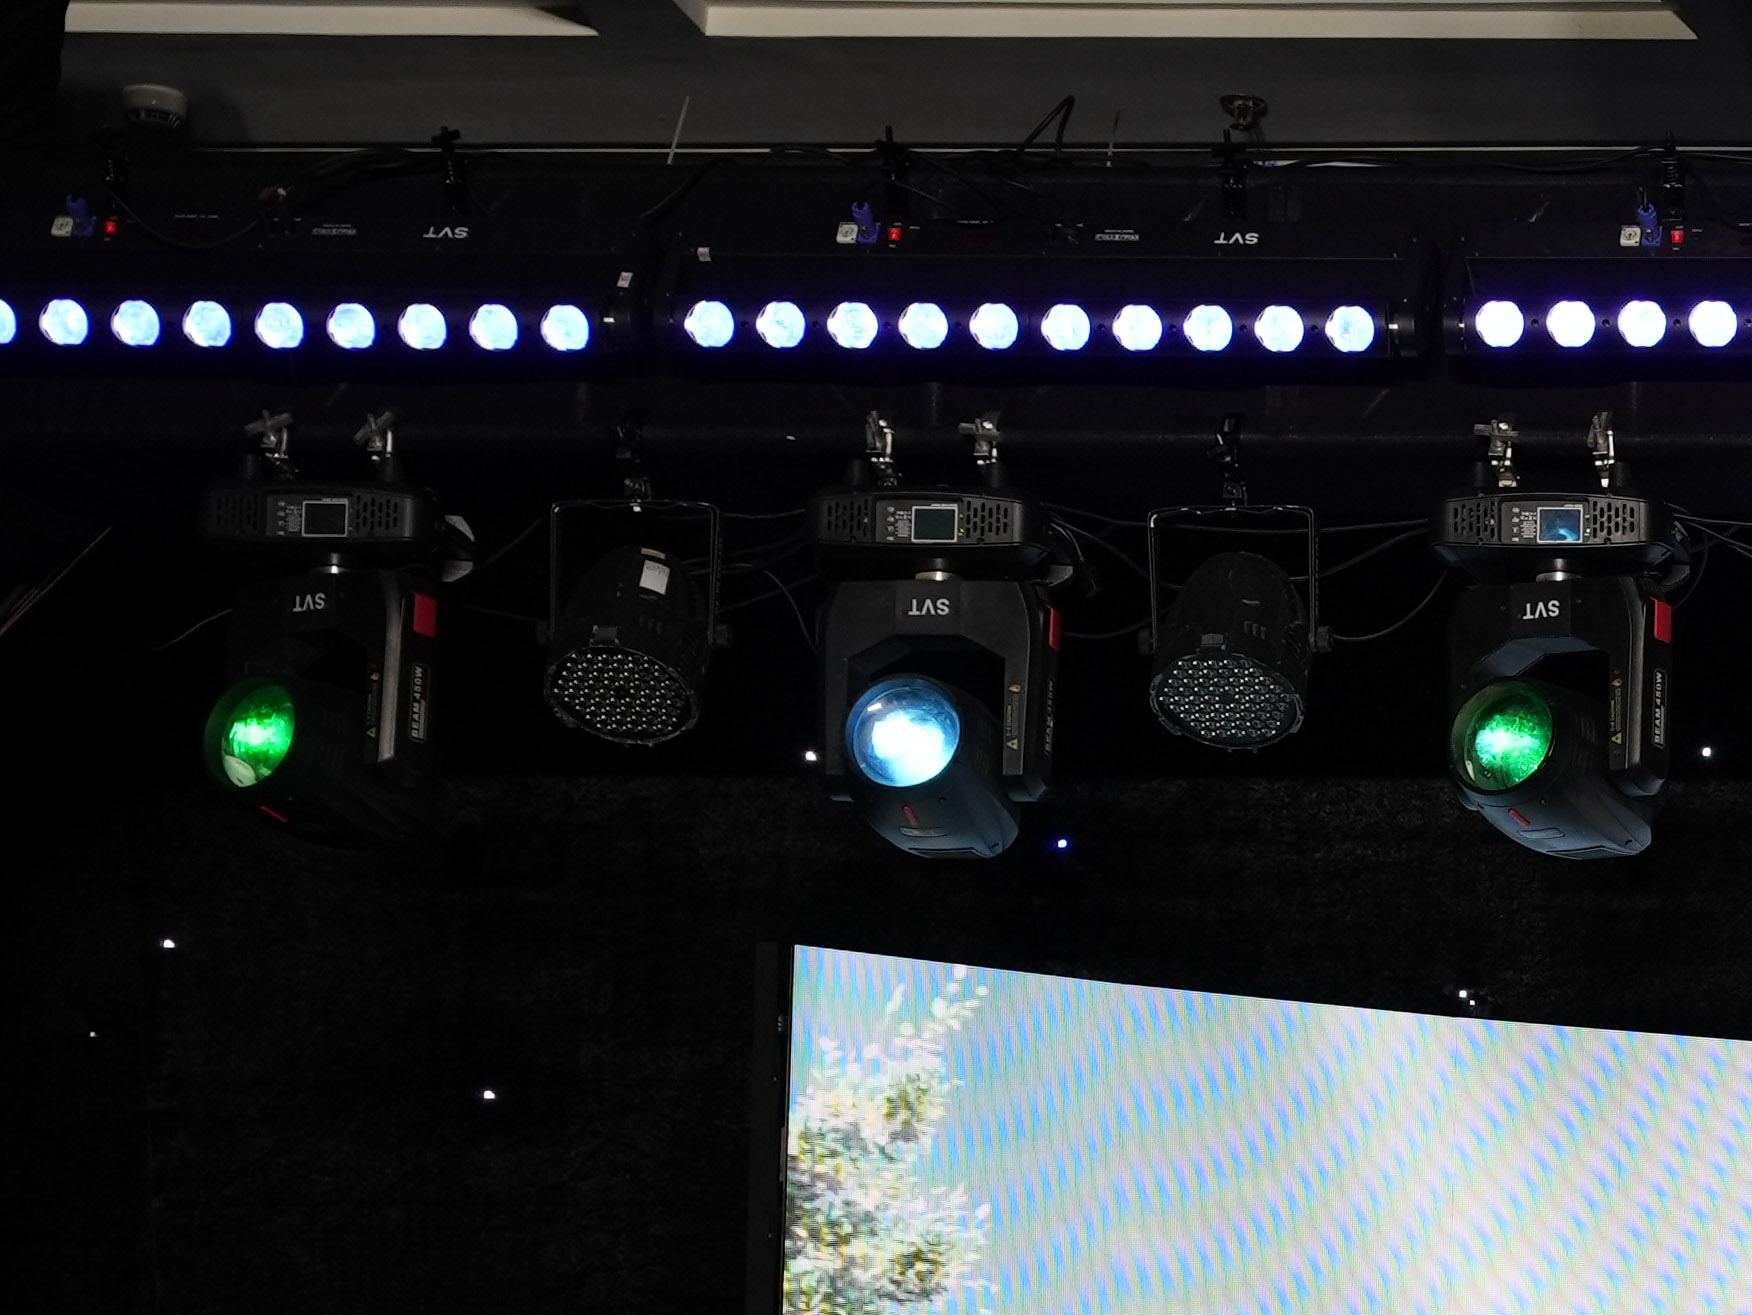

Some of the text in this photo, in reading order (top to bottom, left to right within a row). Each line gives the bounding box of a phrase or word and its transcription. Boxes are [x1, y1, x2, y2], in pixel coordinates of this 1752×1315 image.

[423, 226, 469, 238] SVT
[1214, 232, 1259, 244] SVT
[293, 593, 325, 612] SVT
[908, 599, 949, 615] SVT
[1523, 600, 1559, 619] SVT
[411, 665, 423, 738] BEAM 450W
[1654, 708, 1662, 743] BEAM
